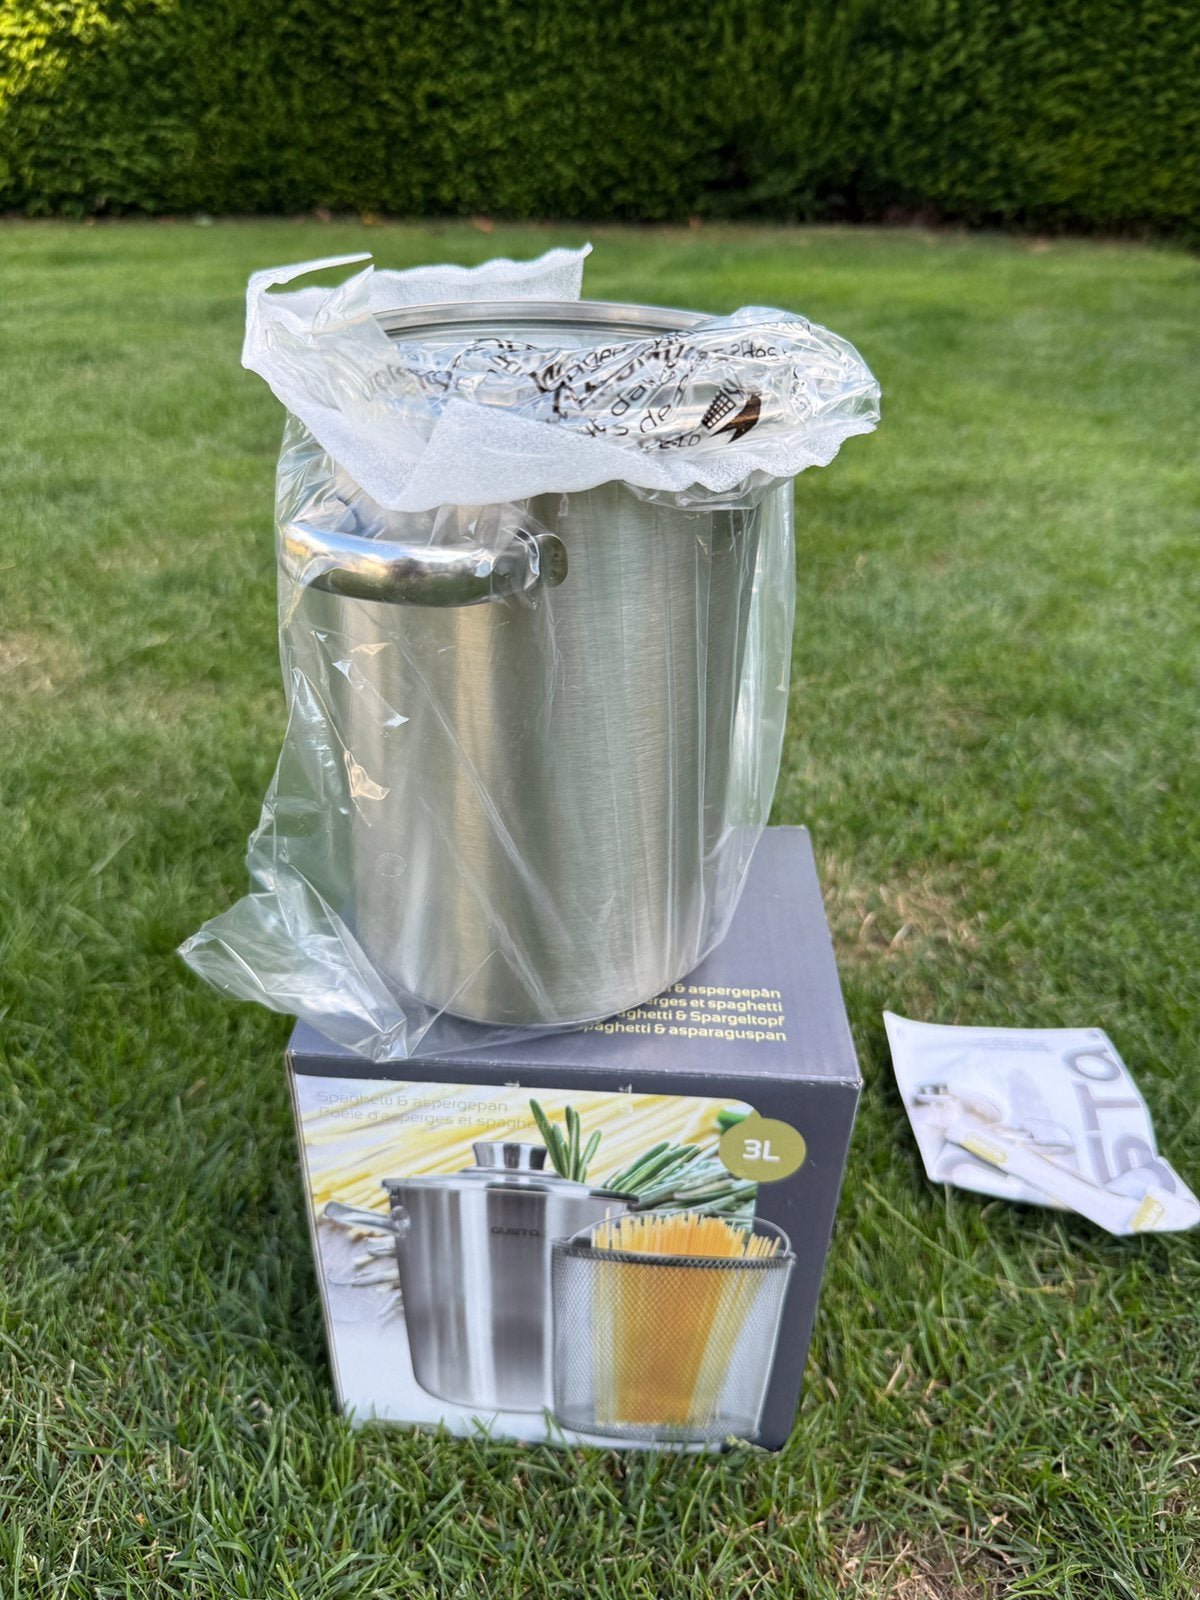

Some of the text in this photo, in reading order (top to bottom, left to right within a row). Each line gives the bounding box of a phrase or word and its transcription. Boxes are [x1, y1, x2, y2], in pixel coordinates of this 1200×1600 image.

[645, 997, 782, 1013] erges et spaghetti
[616, 1008, 785, 1028] aghetti & Spargeltopf
[654, 1023, 666, 1034] &
[668, 1026, 787, 1042] asparaguspan
[316, 1090, 508, 1112] Spaghetti & aspergepan
[458, 1117, 473, 1125] et
[742, 1138, 781, 1162] 3L
